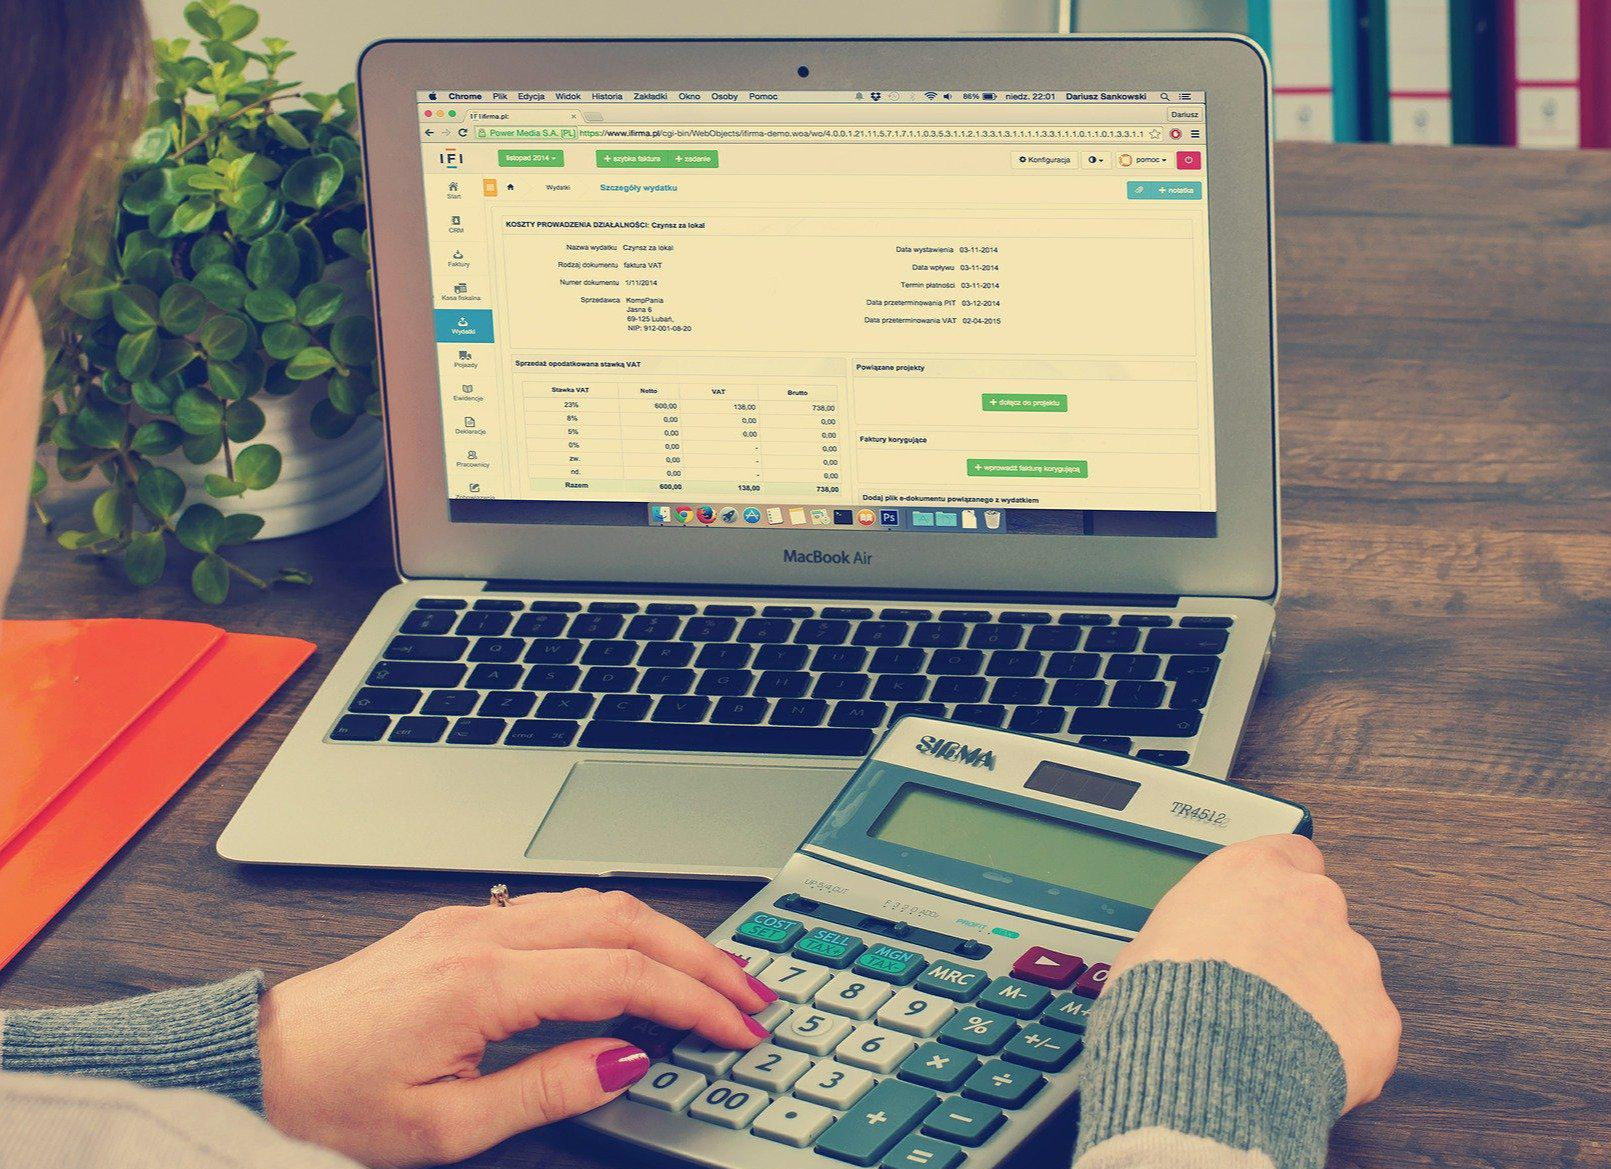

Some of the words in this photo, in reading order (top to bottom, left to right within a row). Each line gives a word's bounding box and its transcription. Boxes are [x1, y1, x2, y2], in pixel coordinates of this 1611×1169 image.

[517, 93, 545, 101] Edycja
[711, 93, 738, 101] Osoby
[490, 129, 515, 137] Power
[517, 129, 541, 137] Media
[543, 129, 559, 137] S.A.
[560, 128, 576, 139] [PL]
[1028, 156, 1070, 164] Konfiguracja
[546, 184, 571, 192] Wydatki
[600, 183, 641, 193] Szczegóły
[643, 184, 677, 193] wydatku
[593, 220, 649, 229] DZIAŁALNOŚCI:
[651, 222, 677, 230] Czynsz
[590, 244, 617, 252] wydatku
[622, 244, 647, 252] Czynsz
[913, 246, 954, 255] wystawienia
[959, 246, 998, 254] 03-11-2014
[448, 261, 470, 269] Faktury
[557, 261, 581, 270] Rodzaj
[582, 261, 619, 269] dokumentu
[625, 279, 657, 287] 1/11/2014
[580, 297, 620, 305] Sprzedawca
[626, 297, 664, 305] KompPania
[884, 300, 942, 308] przeterminowania
[882, 317, 941, 325] przeterminowania
[451, 328, 476, 336] Wydatki
[454, 362, 478, 370] Pojazdy
[515, 360, 547, 368] Sprzedaż
[548, 360, 599, 369] opodatkowana
[600, 360, 625, 369] stawką
[856, 364, 894, 372] Powiązane
[896, 364, 924, 373] projekty
[453, 395, 484, 403] Ewidencje
[654, 402, 677, 410] 600,00
[733, 403, 756, 411] 138,00
[812, 404, 835, 412] 738,00
[663, 416, 678, 424] 0,00
[742, 417, 757, 425] 0,00
[821, 418, 836, 426] 0,00
[455, 428, 487, 436] Deklaracje
[859, 436, 887, 444] Faktury
[665, 443, 680, 451] 0,00
[822, 445, 837, 453] 0,00
[456, 461, 490, 469] Pracownicy
[659, 483, 682, 491] 600,00
[738, 485, 760, 493] 138,00
[816, 486, 839, 494] 738,00
[862, 494, 883, 503] Dodaj
[885, 495, 898, 503] plik
[900, 495, 946, 503] e-dokumentu
[1001, 496, 1039, 505] wydatkiem
[883, 513, 896, 523] Ps
[783, 549, 850, 565] MacBook
[853, 550, 873, 565] Air
[489, 644, 501, 652] Q
[544, 645, 560, 653] W
[487, 671, 499, 679] A
[915, 735, 996, 772] SIGMA
[1170, 801, 1227, 825] TR4512
[753, 913, 795, 932] COST
[748, 924, 780, 940] SET
[813, 930, 849, 946] SELL
[875, 945, 912, 961] MGN
[778, 966, 806, 982] 7
[927, 965, 977, 986] MRC
[848, 983, 865, 999] 8
[998, 985, 1028, 1000] M-
[903, 1000, 928, 1016] 9
[798, 1015, 825, 1033] 5
[968, 1016, 988, 1034] %
[861, 1037, 885, 1053] 6
[755, 1054, 781, 1072] 2
[653, 1071, 677, 1089] 0
[818, 1072, 844, 1089] 3
[706, 1086, 750, 1110] 00
